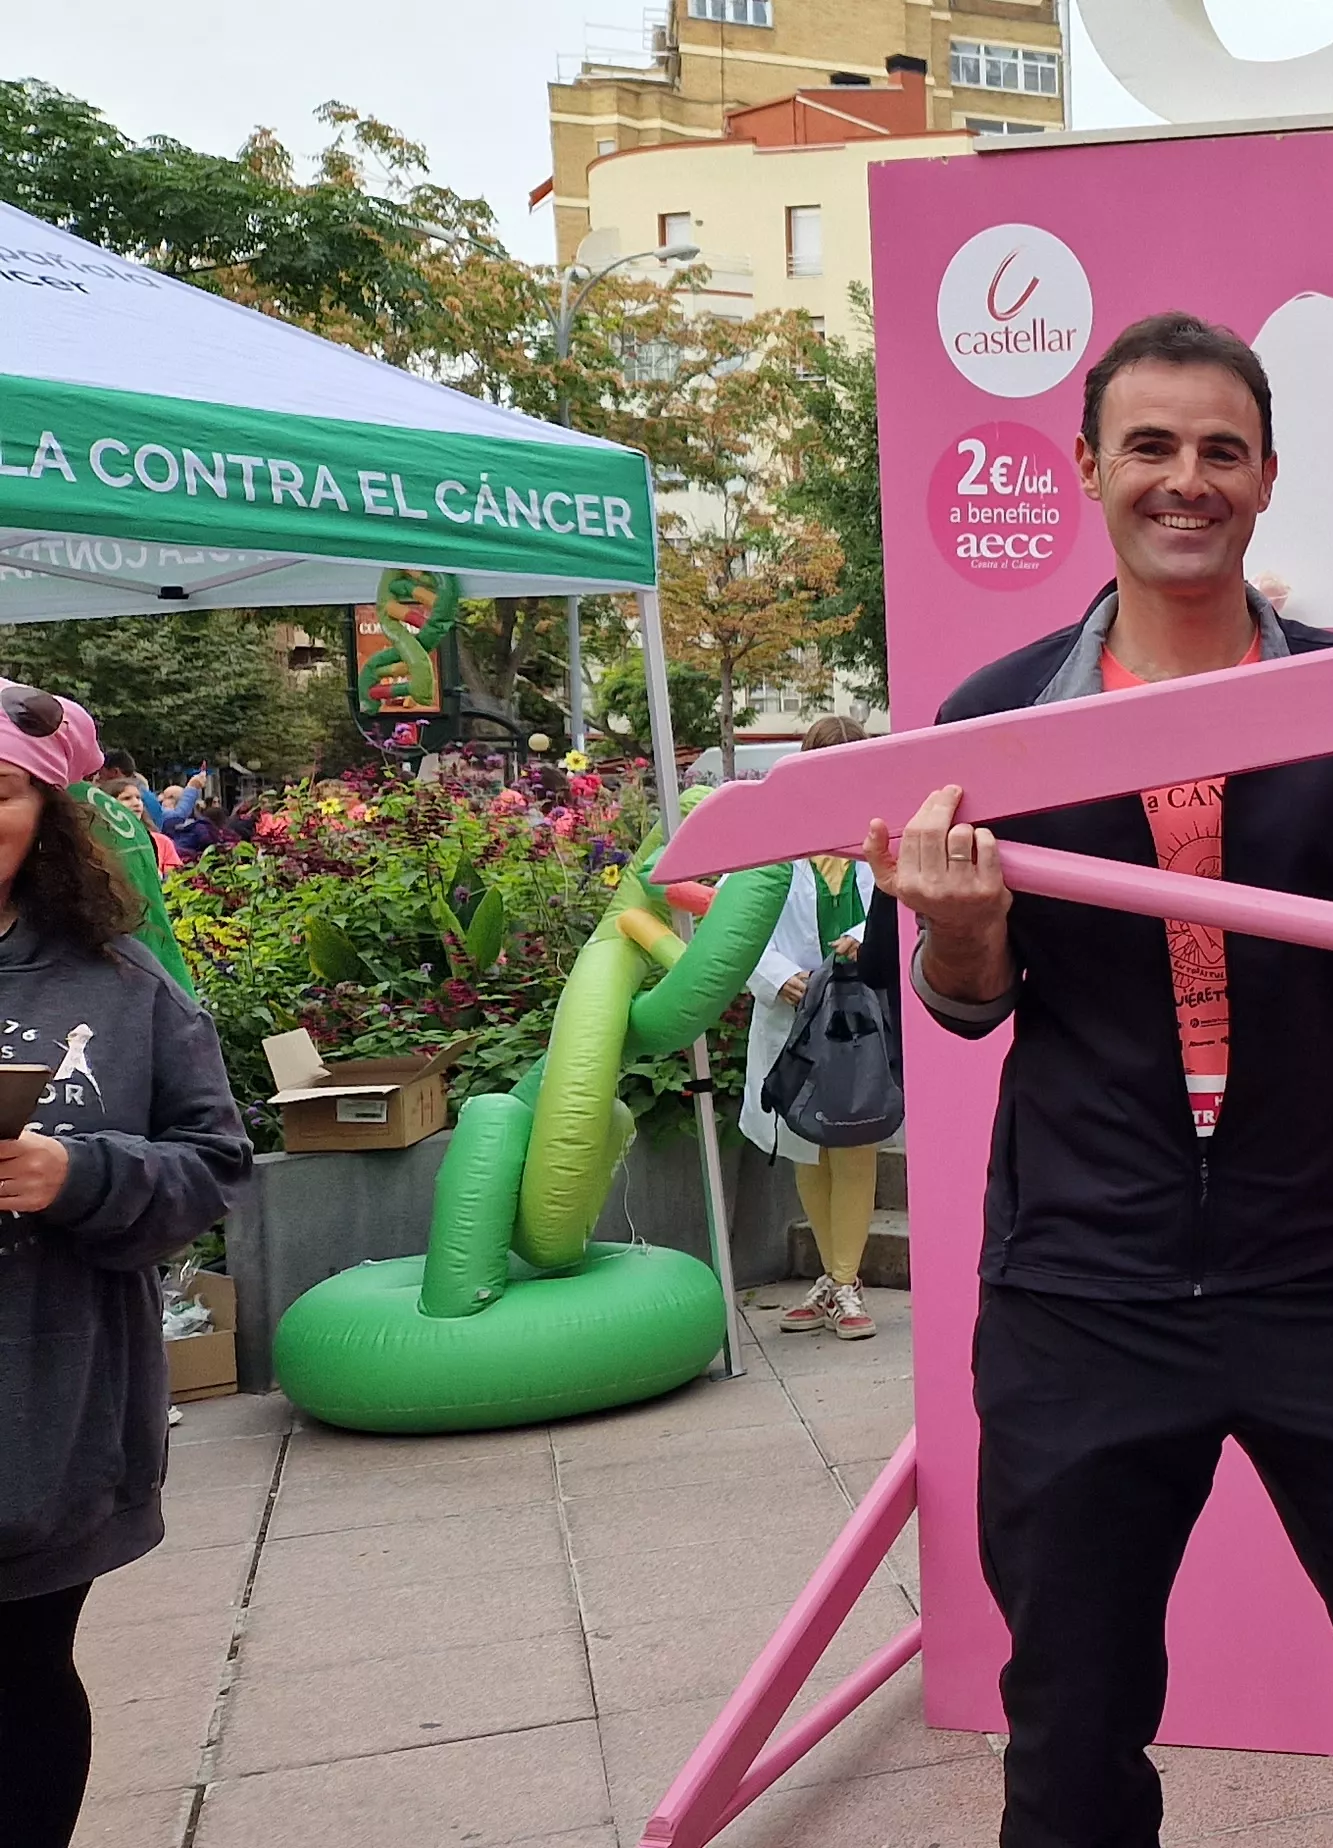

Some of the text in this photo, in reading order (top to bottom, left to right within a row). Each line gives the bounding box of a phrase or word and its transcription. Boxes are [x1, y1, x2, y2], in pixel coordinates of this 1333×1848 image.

[955, 318, 1077, 355] castellar
[89, 437, 349, 513] CONTRA
[358, 470, 428, 520] EL
[436, 470, 635, 540] CÁNCER
[949, 502, 1060, 524] a beneficio
[956, 532, 1053, 559] aecc
[970, 559, 998, 569] Contra
[1001, 558, 1008, 569] el
